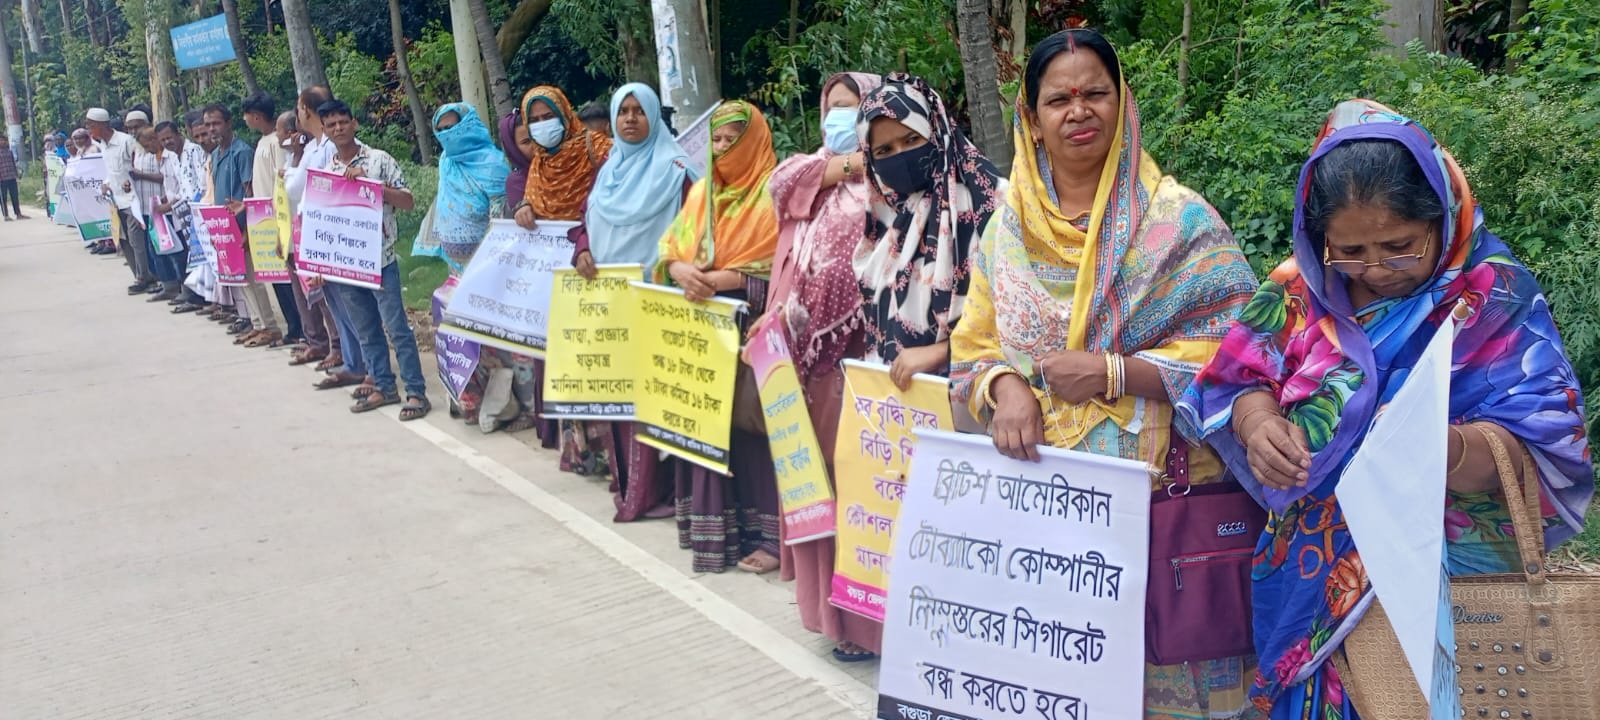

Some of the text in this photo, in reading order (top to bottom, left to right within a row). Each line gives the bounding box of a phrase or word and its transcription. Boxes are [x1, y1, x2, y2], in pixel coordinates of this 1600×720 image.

[315, 229, 334, 245] বিড়ি
[334, 251, 355, 265] দিতে
[358, 259, 375, 270] হবে
[562, 273, 583, 295] বিড়ি
[578, 298, 609, 318] বিরুদ্ধে
[576, 354, 611, 371] ষড়যন্ত্র
[551, 373, 583, 393] মানিনা
[704, 392, 722, 415] টাকা
[877, 396, 906, 432] বৃদ্ধি
[860, 429, 892, 466] বিড়ি
[933, 458, 1112, 527] ব্রিটিশ আমেরিকান
[846, 504, 893, 538] কৌশল
[908, 520, 1124, 601] টোব্যাকো কোম্পানীর
[1013, 606, 1106, 664] সিগারেট
[919, 662, 955, 699] বন্ধ
[961, 672, 1028, 714] করতে
